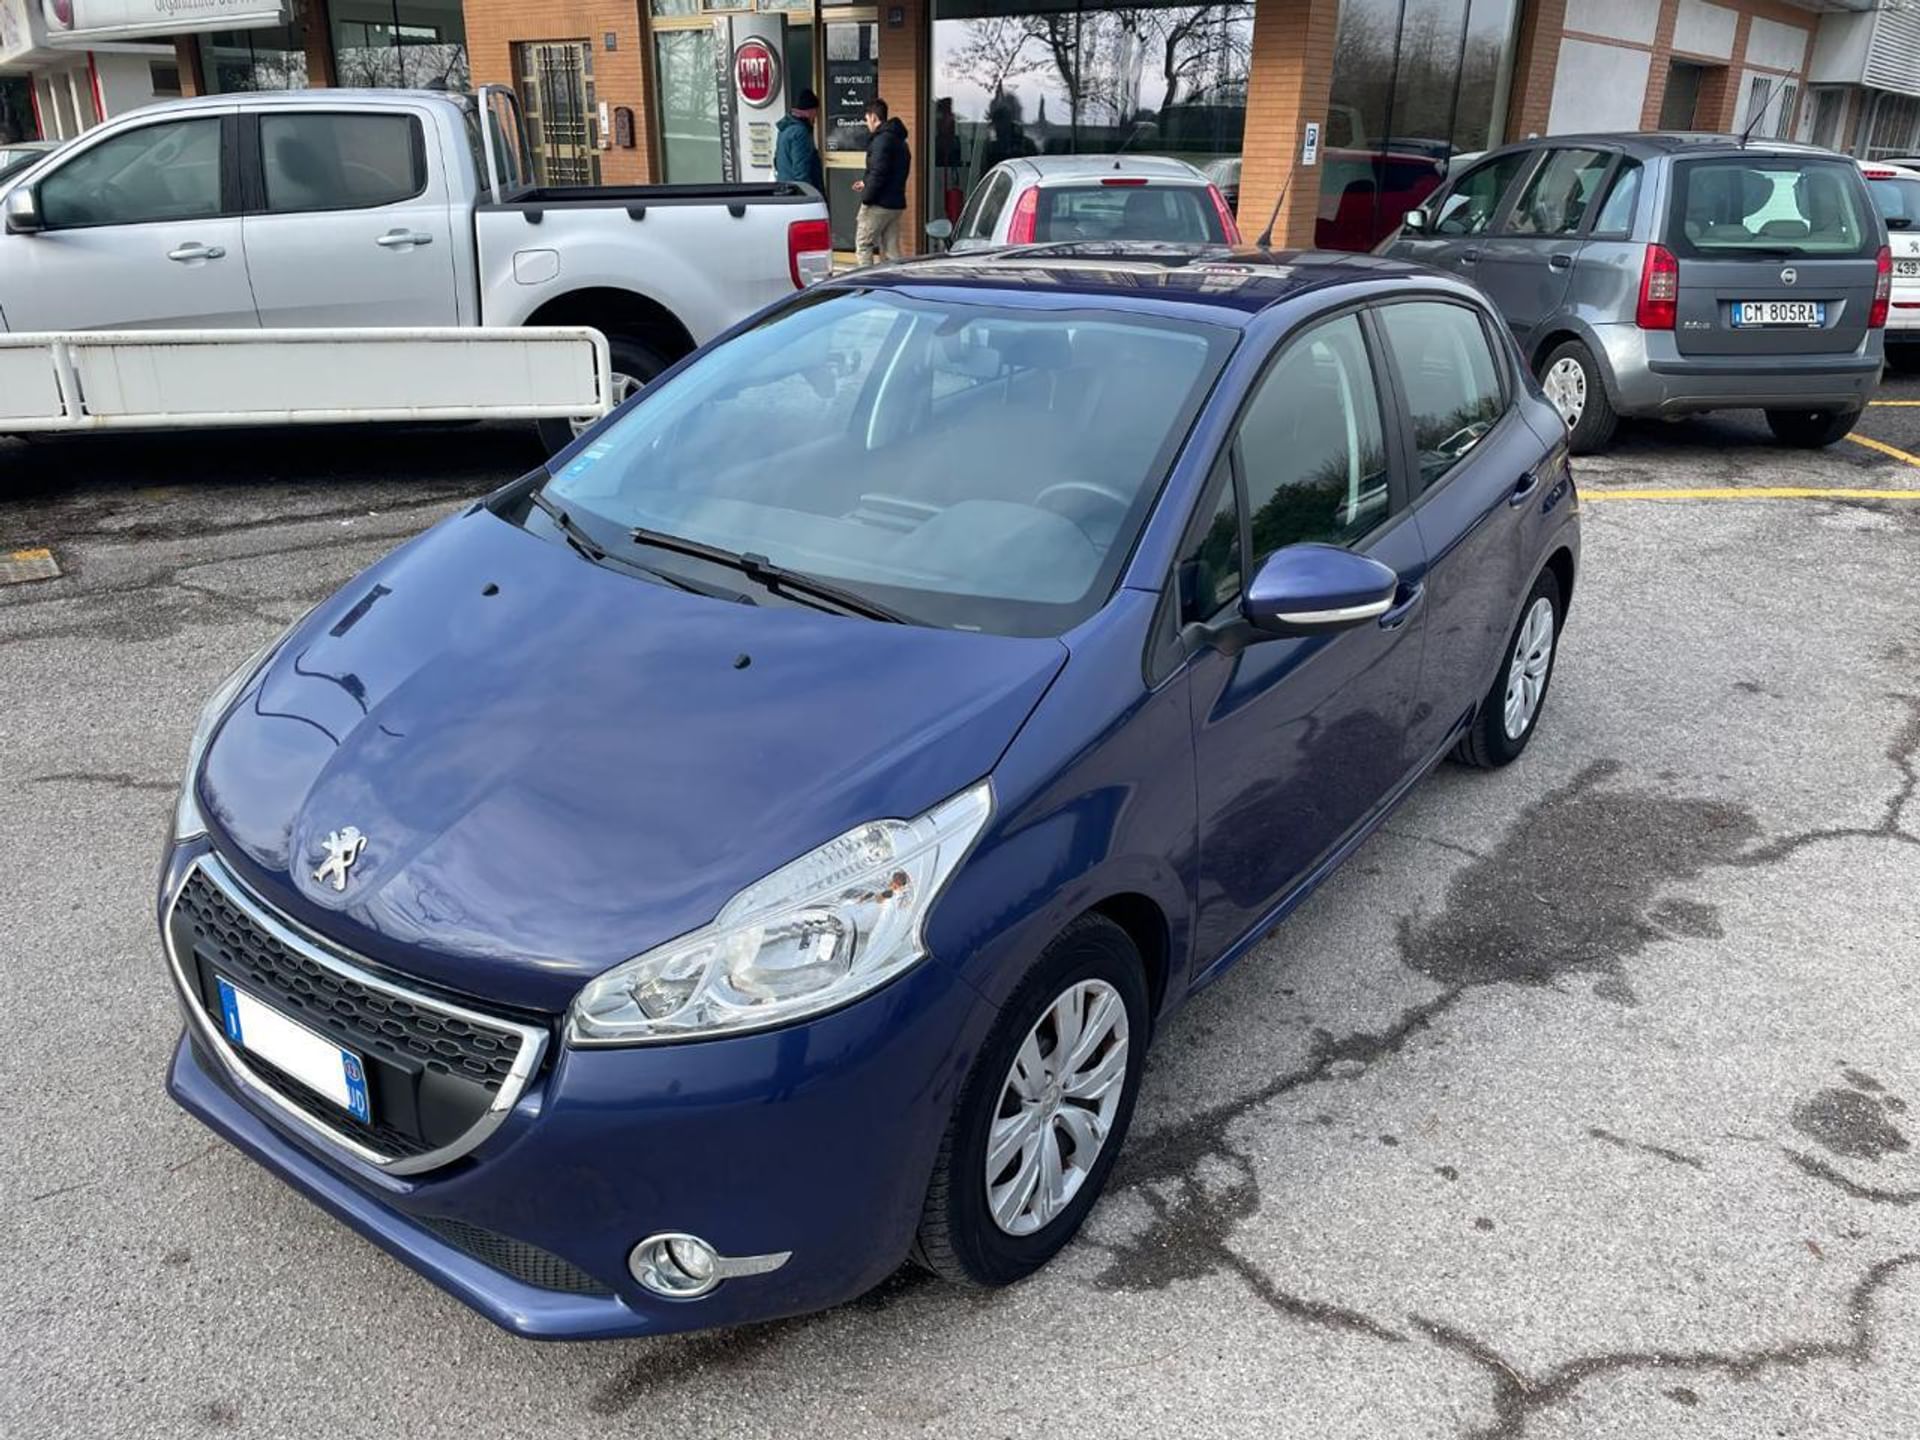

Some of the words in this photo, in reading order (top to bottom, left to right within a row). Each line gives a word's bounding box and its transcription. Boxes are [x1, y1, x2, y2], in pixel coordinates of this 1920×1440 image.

[741, 57, 767, 89] FIAT
[1744, 304, 1763, 320] CM
[1770, 304, 1815, 321] 805RA
